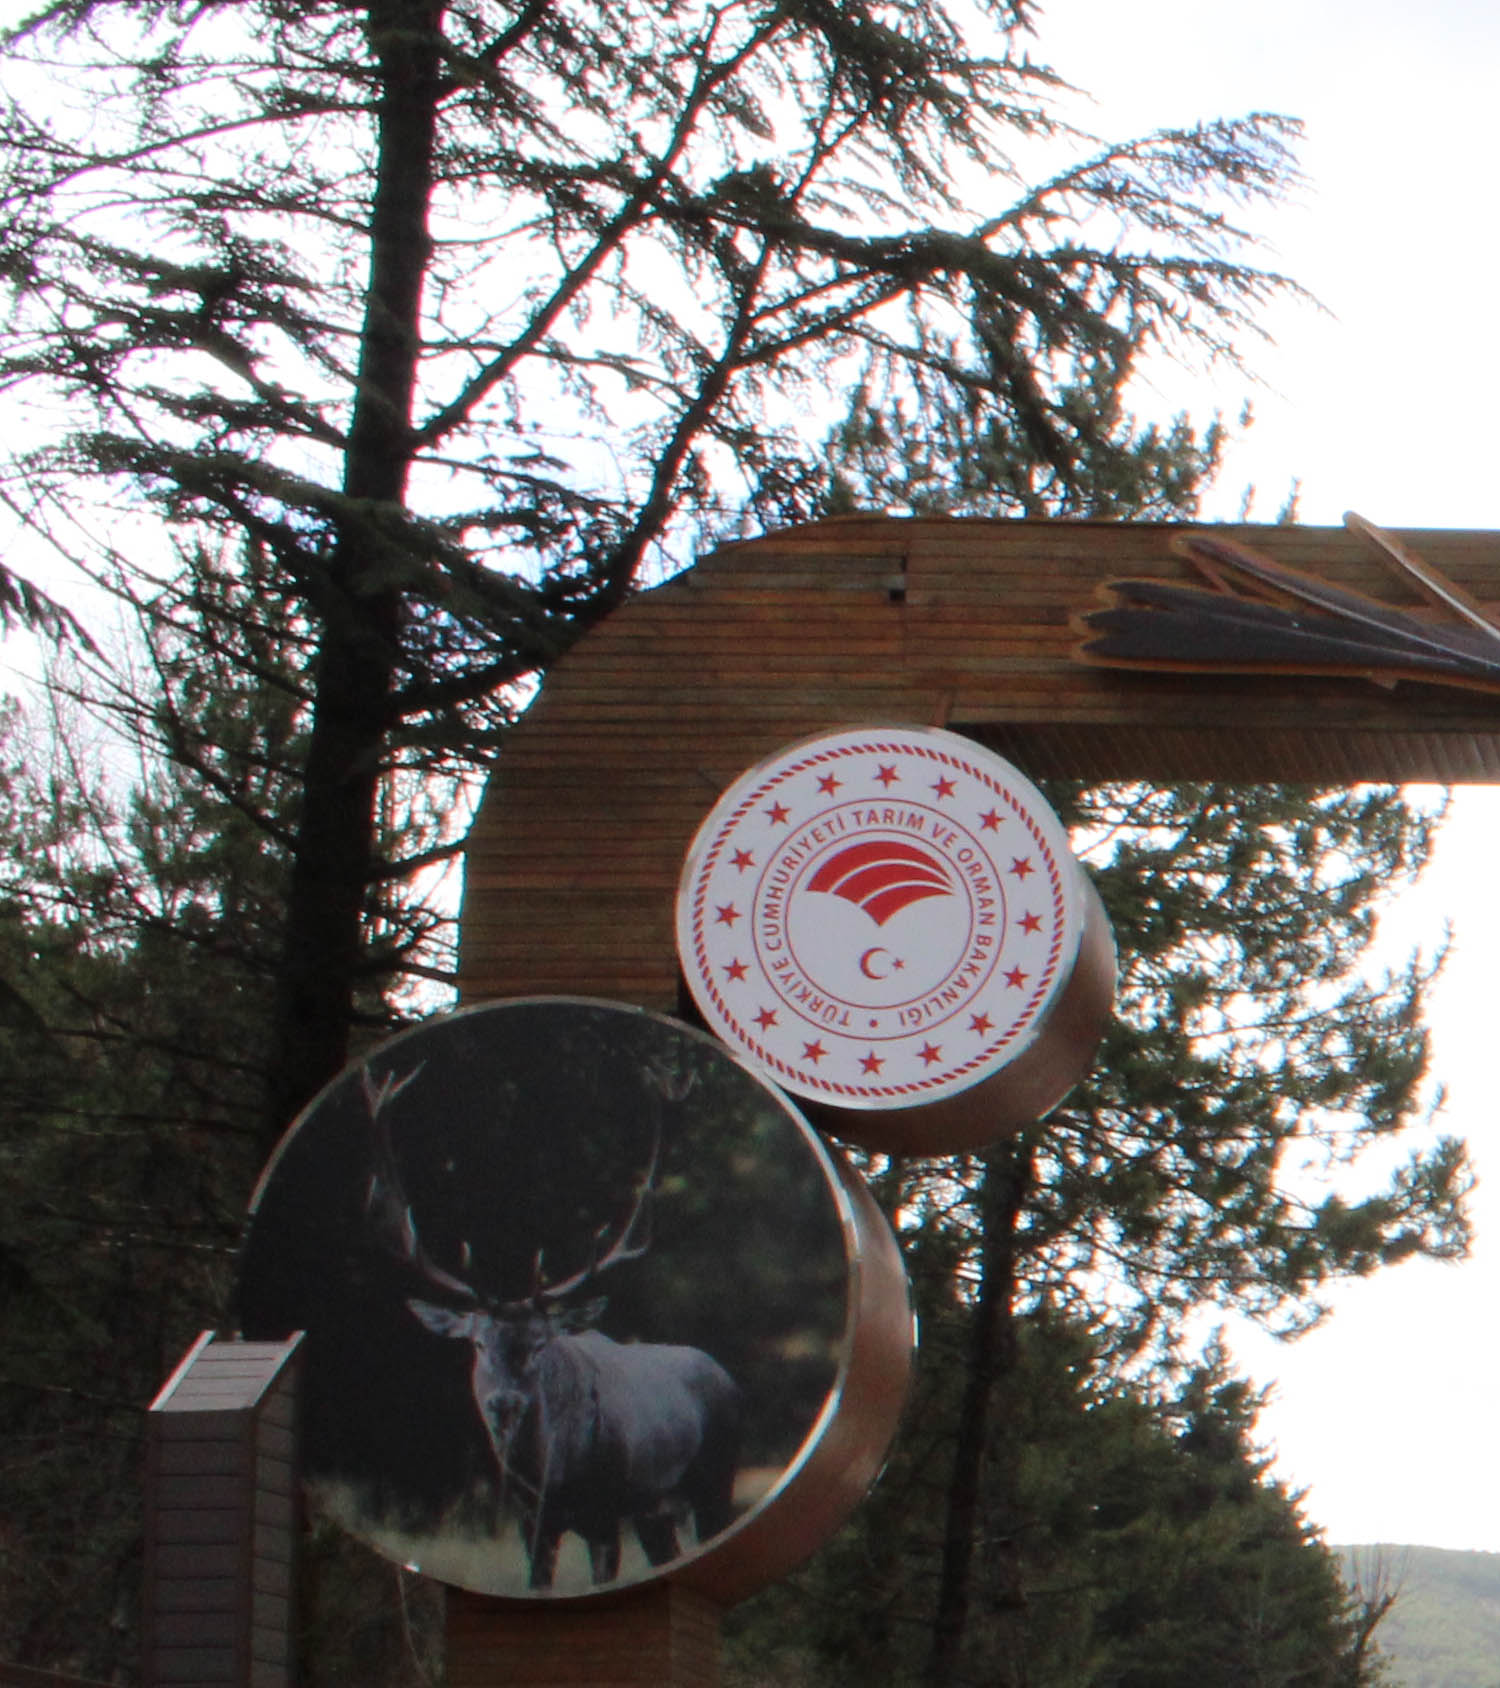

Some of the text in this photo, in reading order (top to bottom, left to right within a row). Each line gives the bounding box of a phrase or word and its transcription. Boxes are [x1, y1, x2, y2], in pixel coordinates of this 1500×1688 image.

[763, 809, 996, 1028] TÜRKİYE CUMHURİYETİ TARIM VE ORMAN BAKANLIĞI
